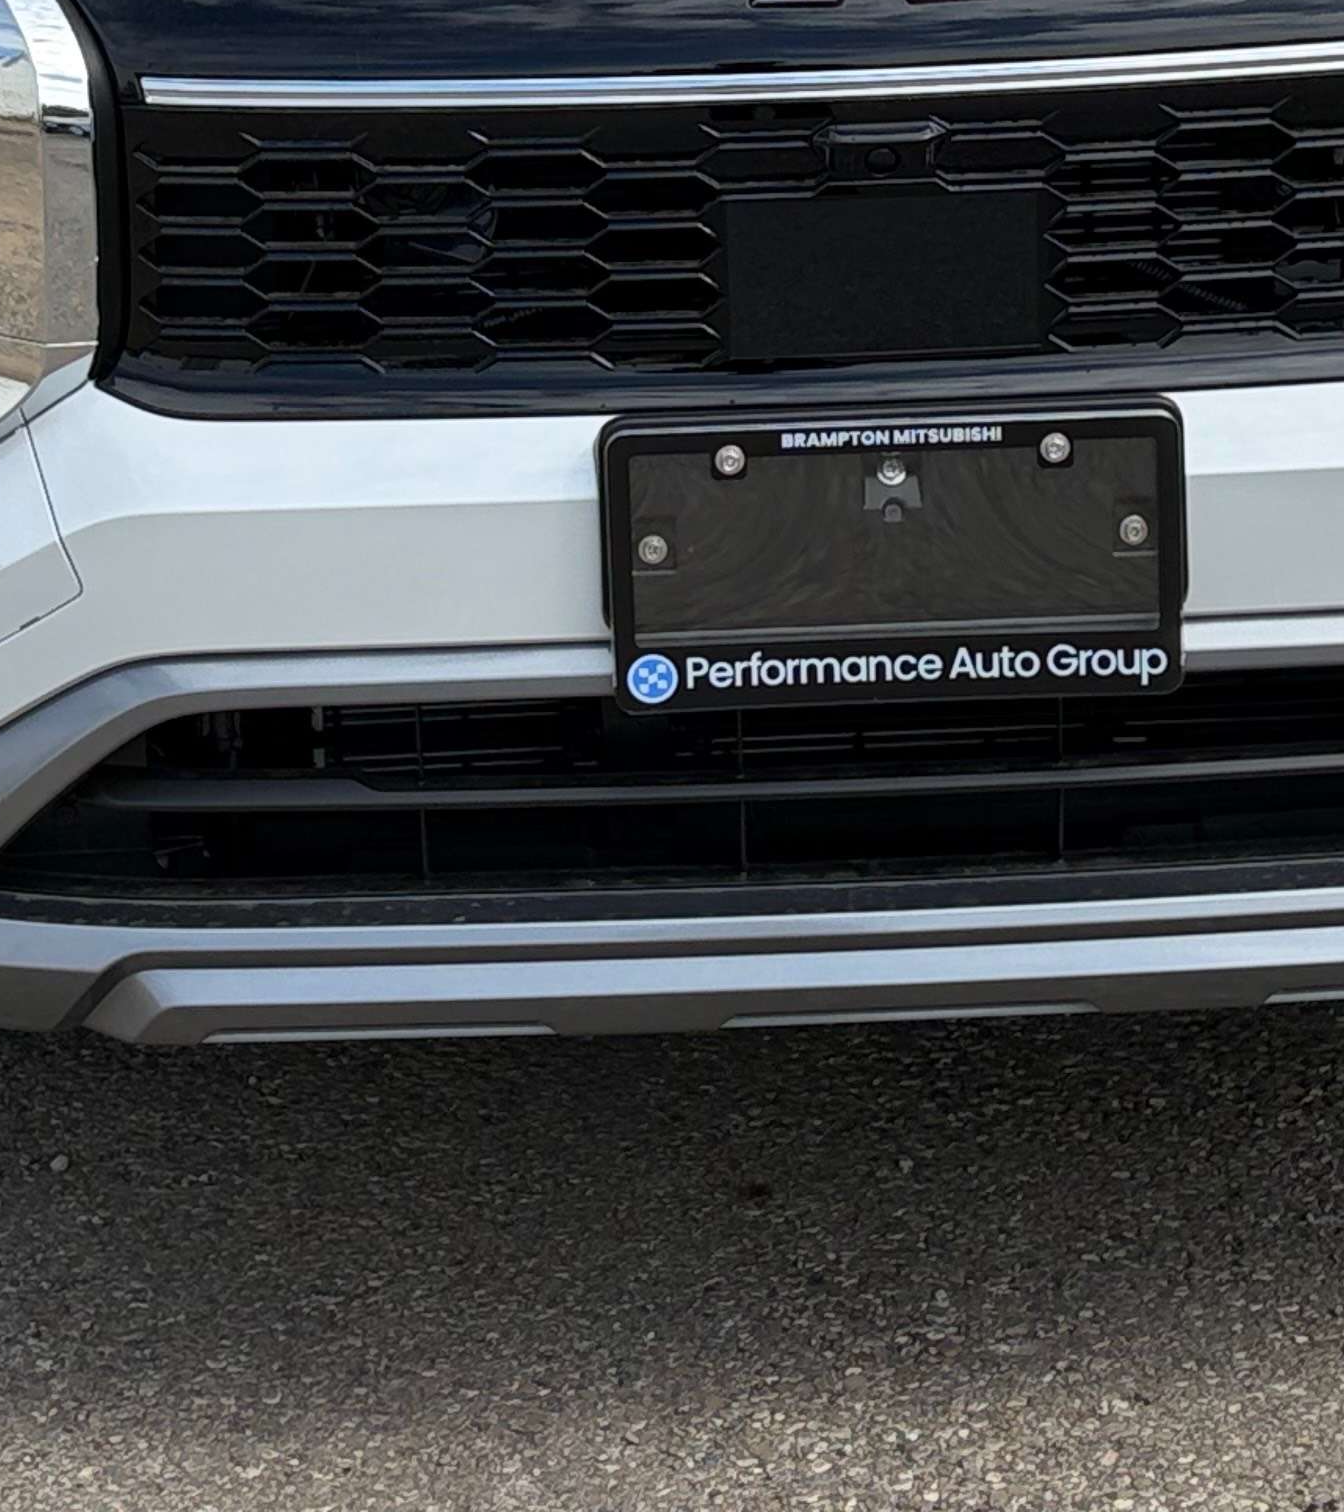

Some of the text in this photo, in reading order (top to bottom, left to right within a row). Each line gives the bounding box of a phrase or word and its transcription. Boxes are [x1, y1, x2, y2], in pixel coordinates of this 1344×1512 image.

[781, 426, 1002, 449] BRAMPTON MITSUBISHI
[686, 644, 1168, 690] Performance Auto Group
